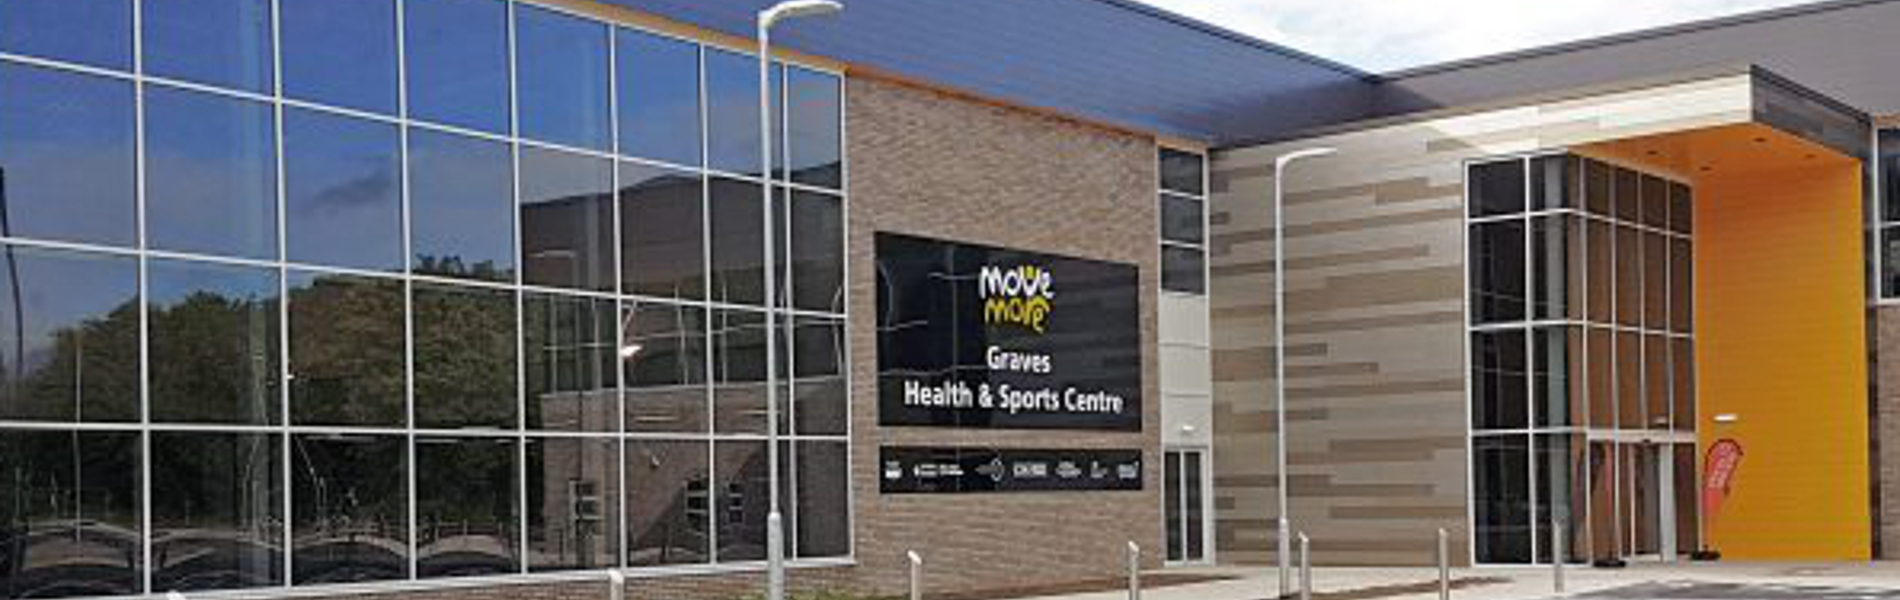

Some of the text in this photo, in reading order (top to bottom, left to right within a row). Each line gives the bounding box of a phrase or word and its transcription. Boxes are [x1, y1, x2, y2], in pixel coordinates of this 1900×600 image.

[987, 346, 1051, 373] Graves
[904, 380, 1124, 414] Health & Sports Centre
